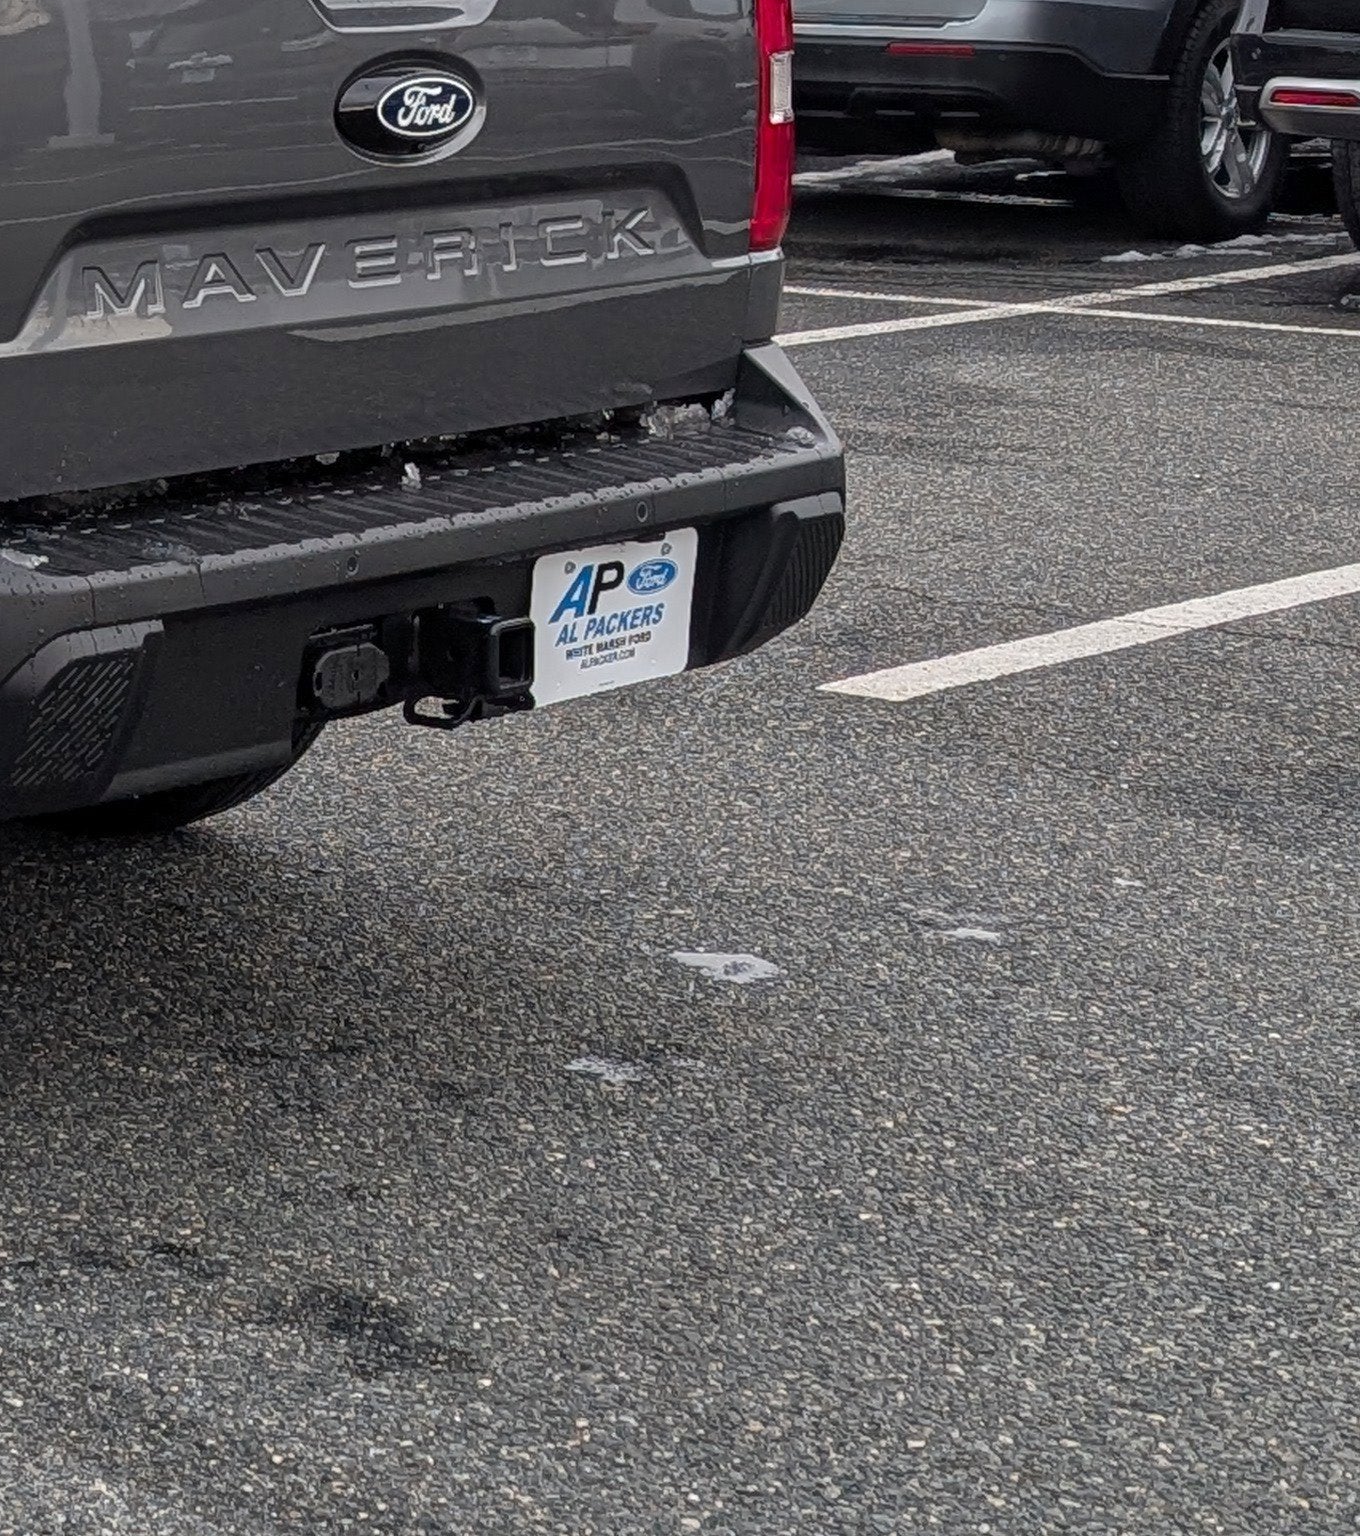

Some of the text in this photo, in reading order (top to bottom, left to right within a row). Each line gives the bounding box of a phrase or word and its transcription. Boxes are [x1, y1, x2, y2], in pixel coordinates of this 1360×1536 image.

[397, 86, 457, 128] Ford
[81, 207, 655, 320] MAVERICK
[548, 560, 625, 625] AP
[554, 602, 666, 648] AL PACKERS
[565, 630, 652, 661] WHITE MARSH FORD
